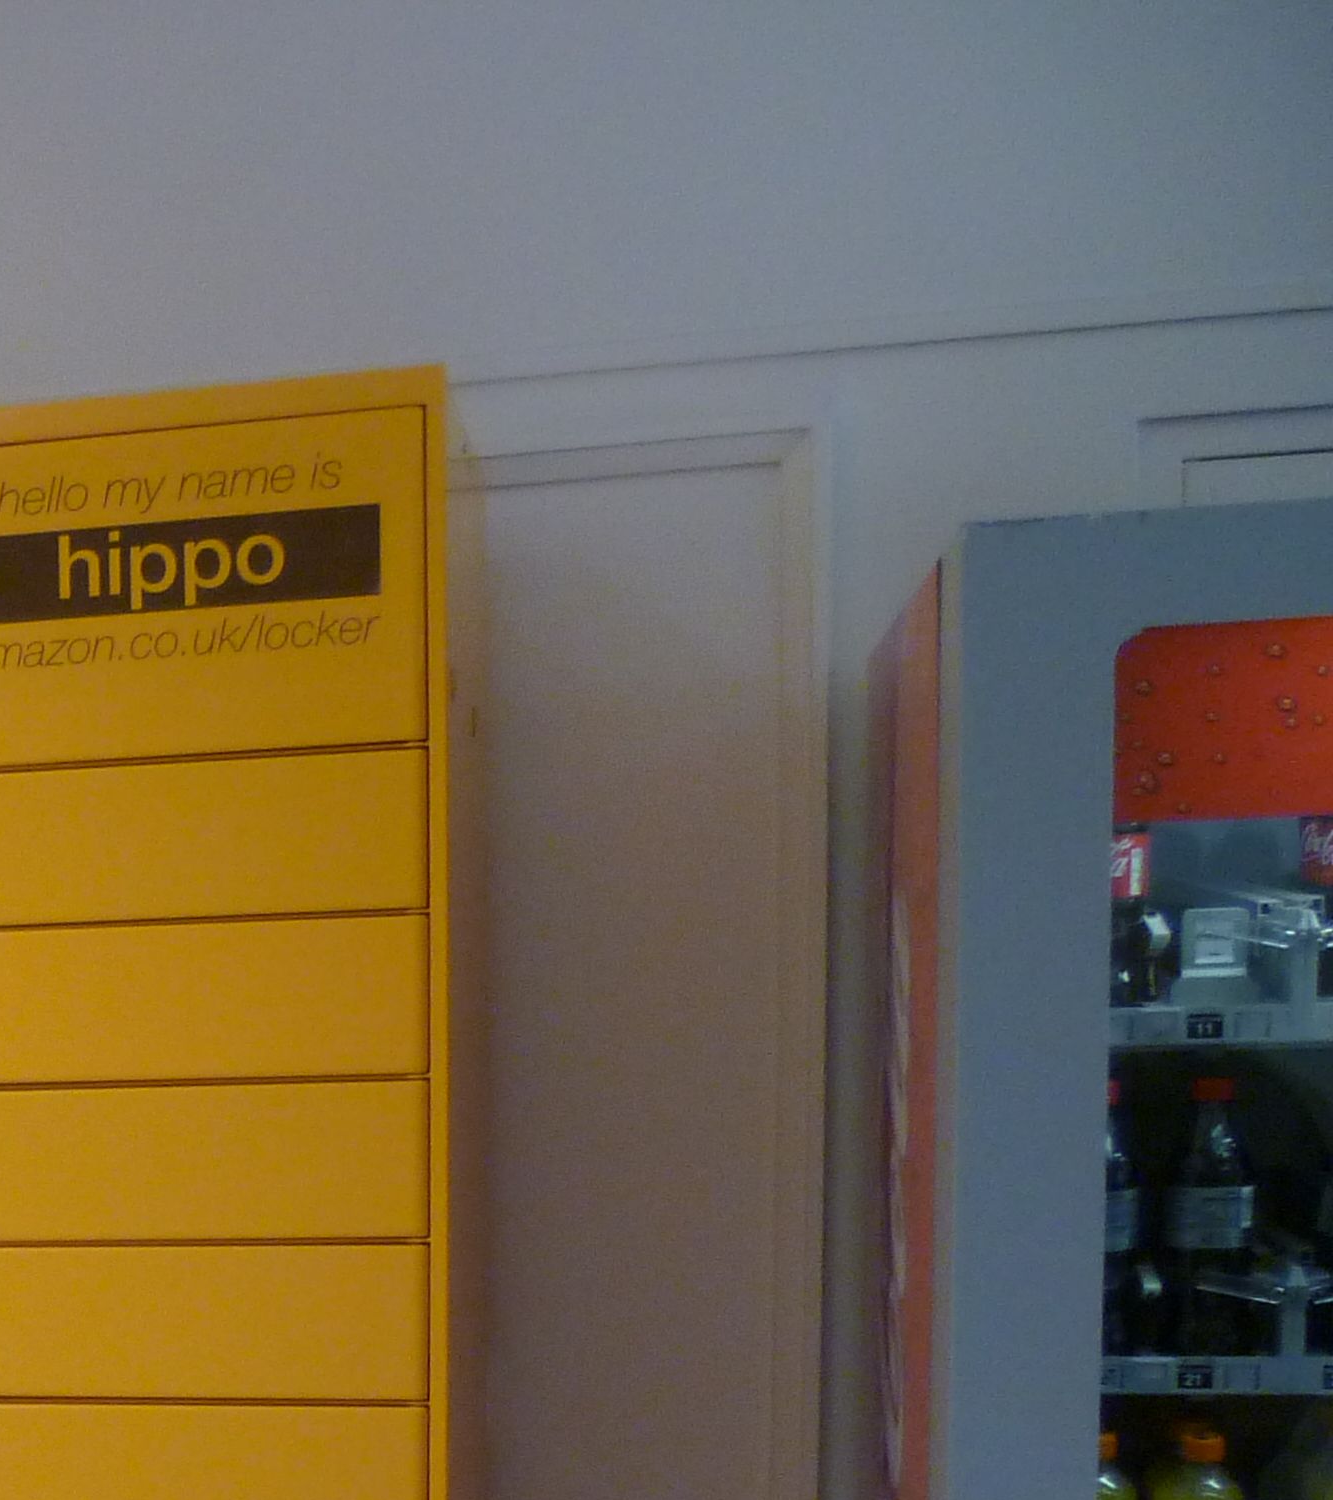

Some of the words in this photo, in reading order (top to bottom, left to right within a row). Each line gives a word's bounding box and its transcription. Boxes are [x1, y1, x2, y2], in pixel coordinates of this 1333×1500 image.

[103, 476, 164, 514] my
[177, 464, 295, 501] name
[309, 453, 343, 491] is
[57, 530, 286, 610] hippo
